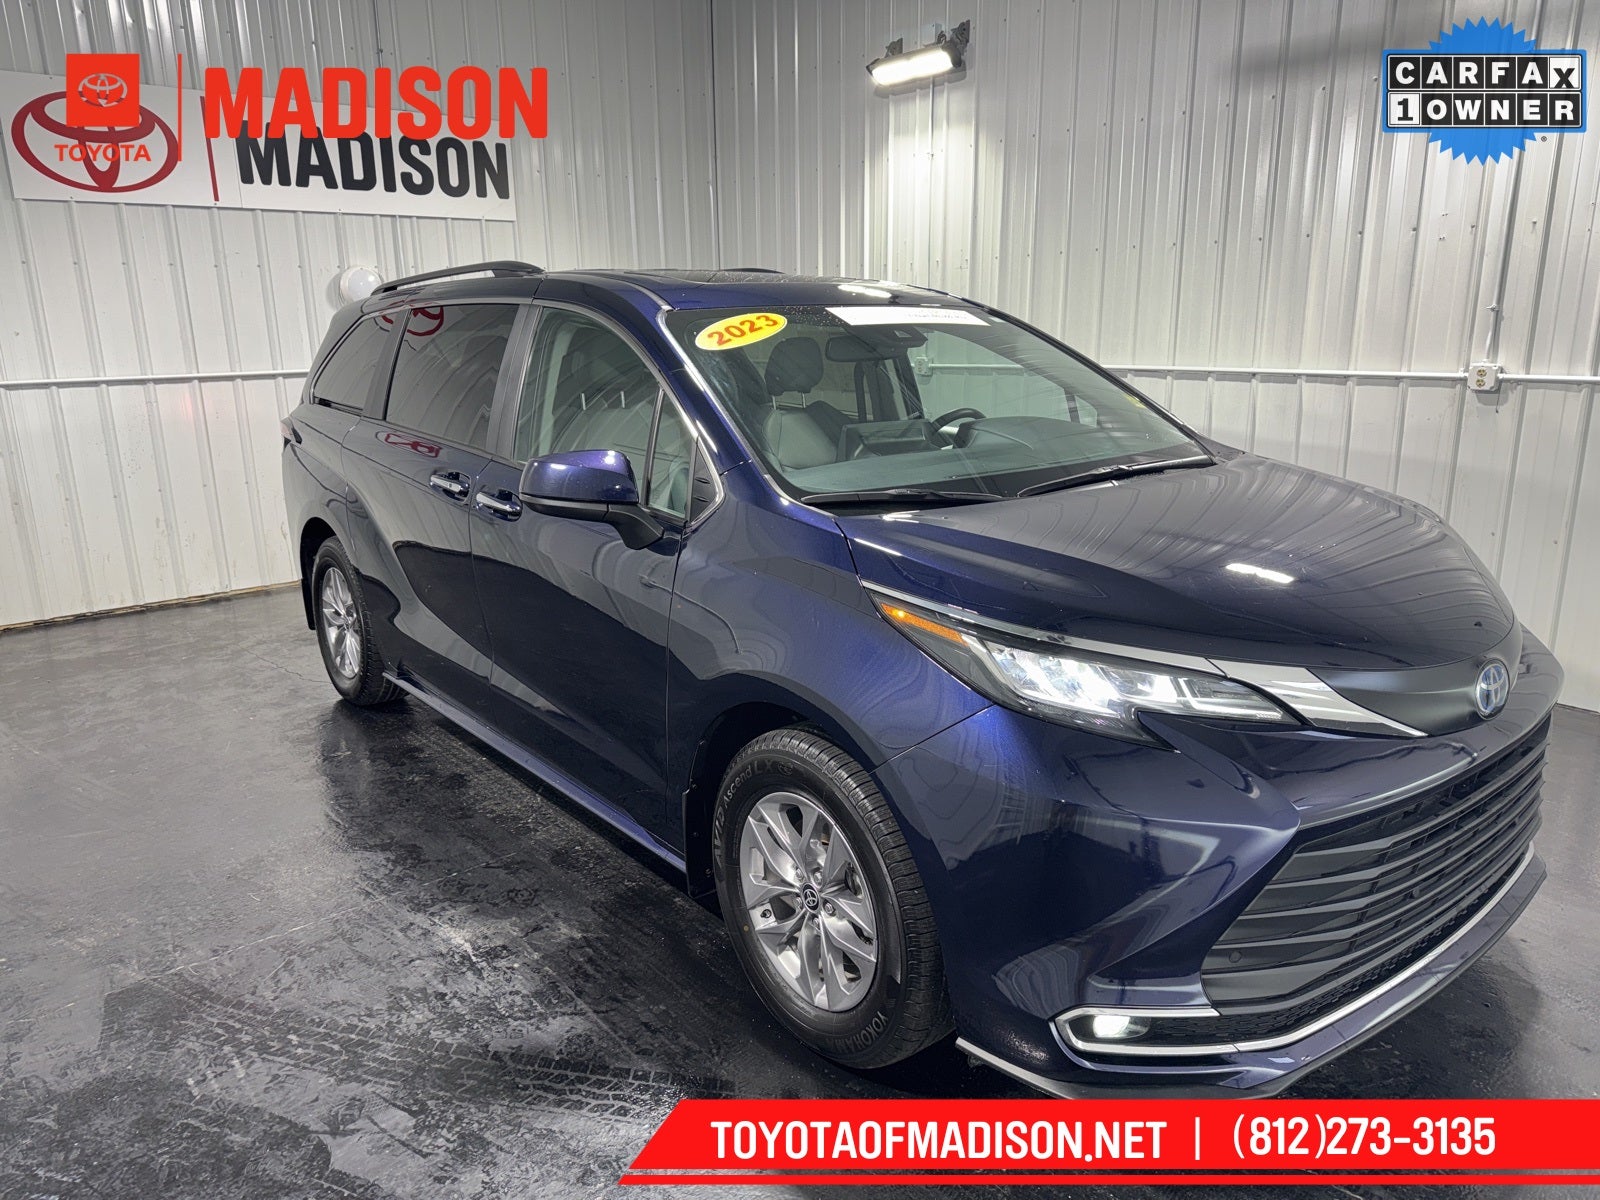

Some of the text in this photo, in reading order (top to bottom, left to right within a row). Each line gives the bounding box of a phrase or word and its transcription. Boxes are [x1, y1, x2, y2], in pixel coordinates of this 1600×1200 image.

[236, 121, 510, 199] MADISON
[707, 315, 779, 346] 2023
[722, 764, 753, 809] Ascend
[825, 1010, 889, 1054] YOKOHAMA
